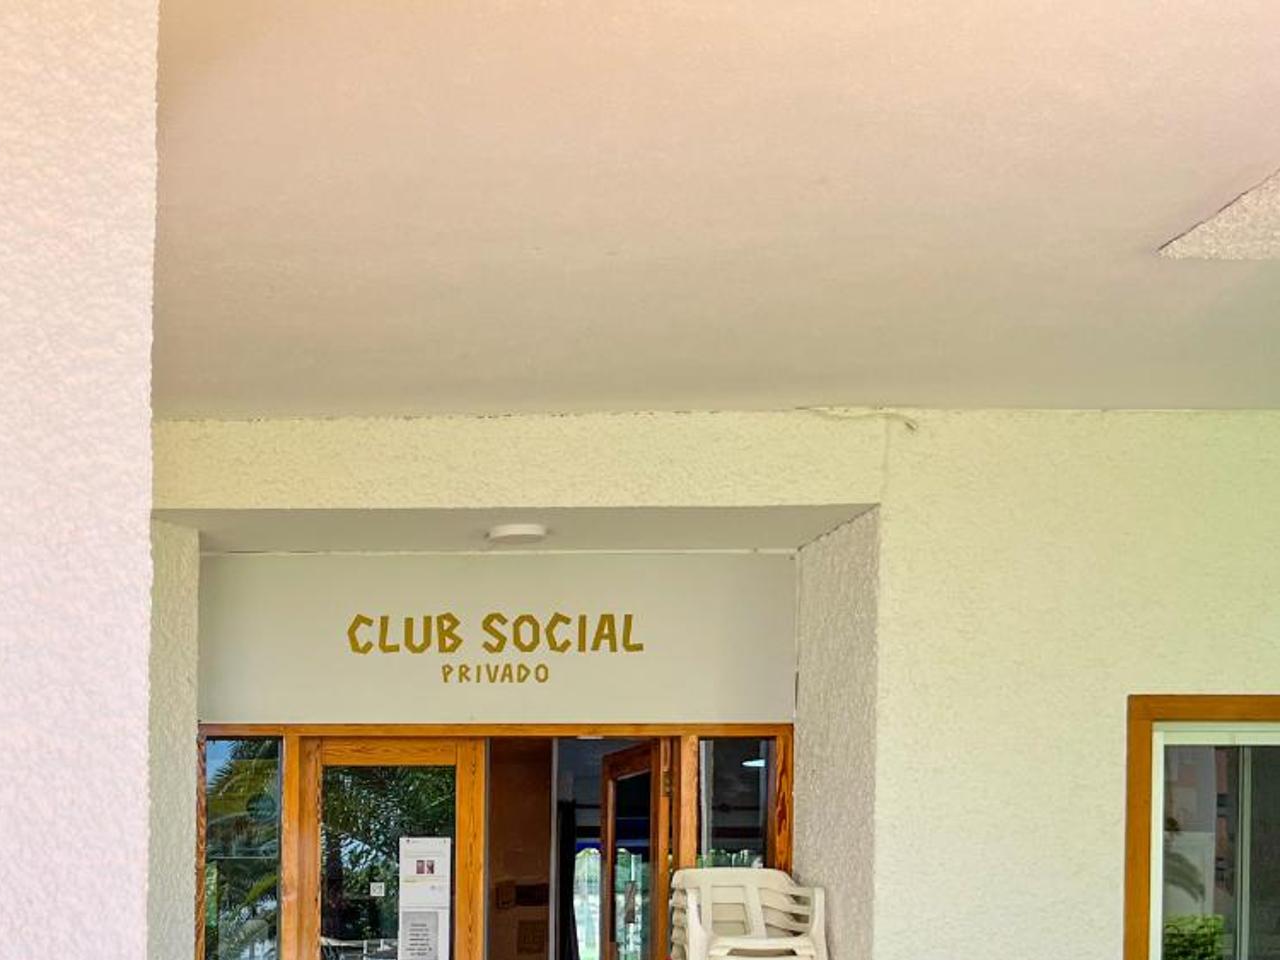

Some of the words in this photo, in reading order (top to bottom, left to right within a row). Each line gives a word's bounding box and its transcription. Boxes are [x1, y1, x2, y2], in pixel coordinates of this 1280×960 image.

[347, 612, 463, 654] CLUB
[482, 612, 644, 653] SOCIAL
[441, 663, 549, 683] PRIVADO
